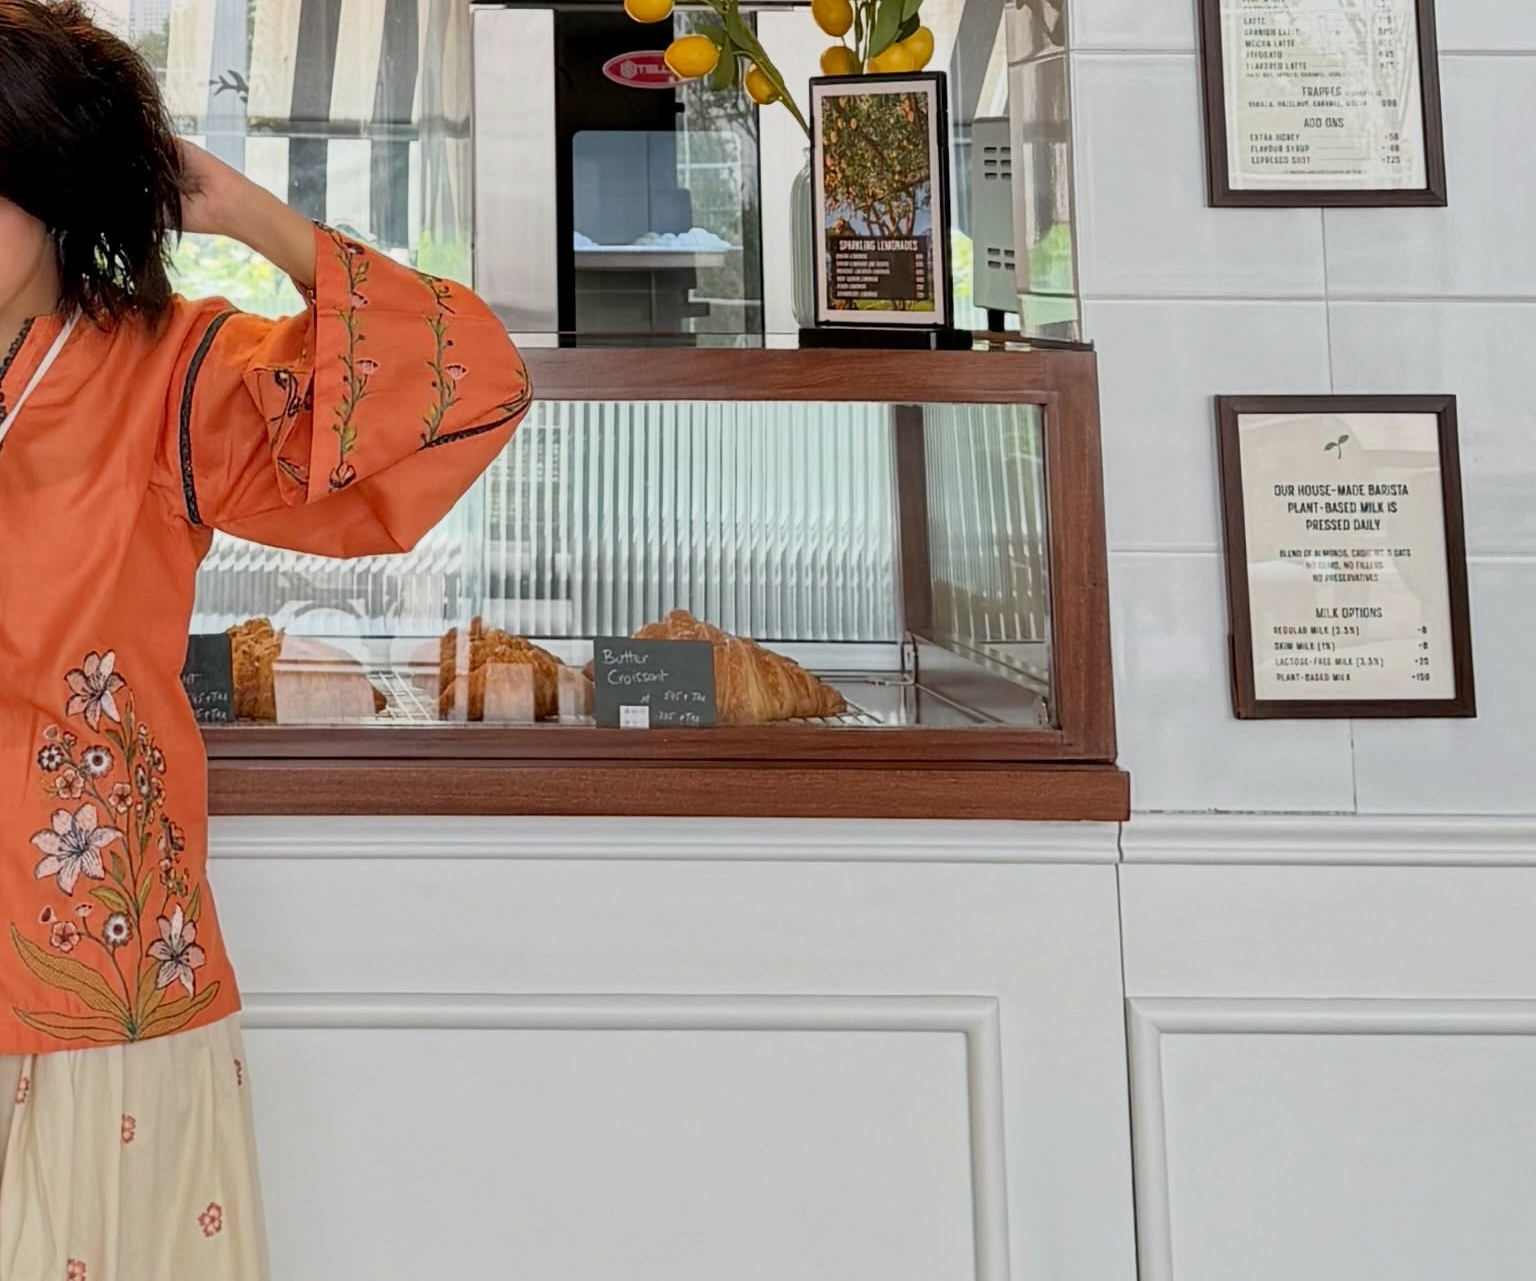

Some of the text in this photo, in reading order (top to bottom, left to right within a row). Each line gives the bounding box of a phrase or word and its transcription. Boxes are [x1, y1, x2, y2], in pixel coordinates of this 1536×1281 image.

[1303, 117, 1344, 128] ADD ONS
[1274, 485, 1409, 496] OUR HOUSE-MADE BARISTA
[1288, 502, 1398, 513] PLANT-BASED MILK IS
[1306, 519, 1380, 530] PRESSED DAILY
[1279, 549, 1302, 557] BLEND
[1315, 607, 1383, 618] MILK OPTIONS
[602, 649, 649, 664] Butter
[607, 669, 669, 685] Croissant
